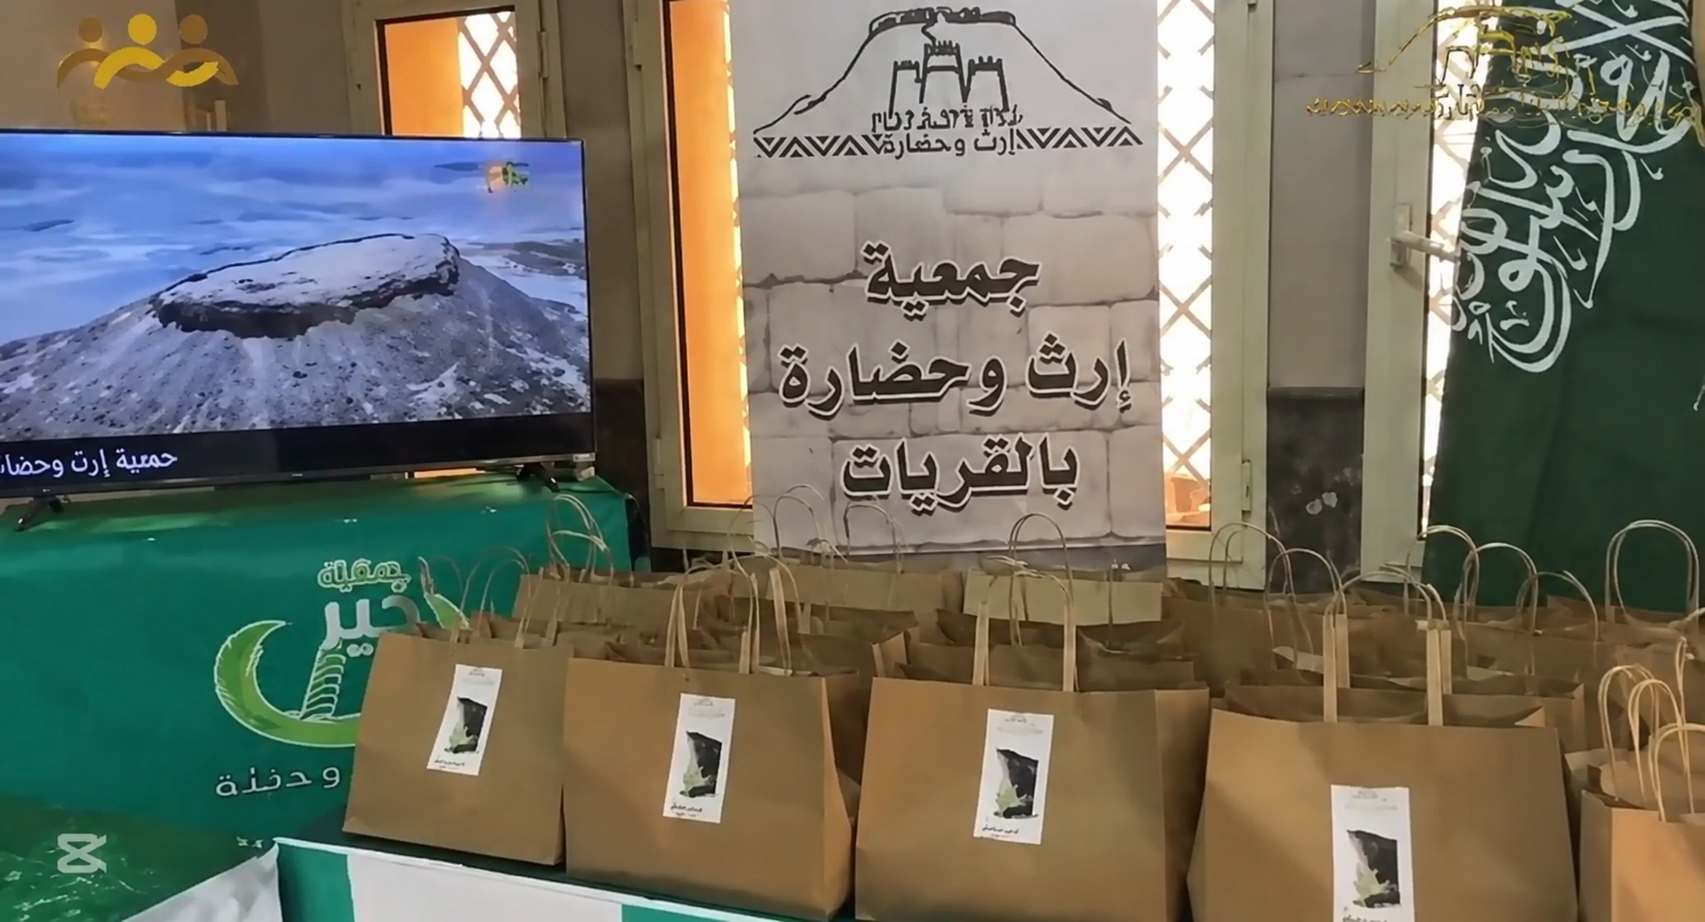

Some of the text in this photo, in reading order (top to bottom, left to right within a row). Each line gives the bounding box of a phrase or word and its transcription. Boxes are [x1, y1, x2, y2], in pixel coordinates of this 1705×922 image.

[881, 130, 966, 160] وحضارة
[862, 240, 1041, 320] جمعية
[778, 331, 1132, 419] إرث وحضارة
[842, 431, 1082, 517] بالقريات
[317, 558, 412, 593] جمعية
